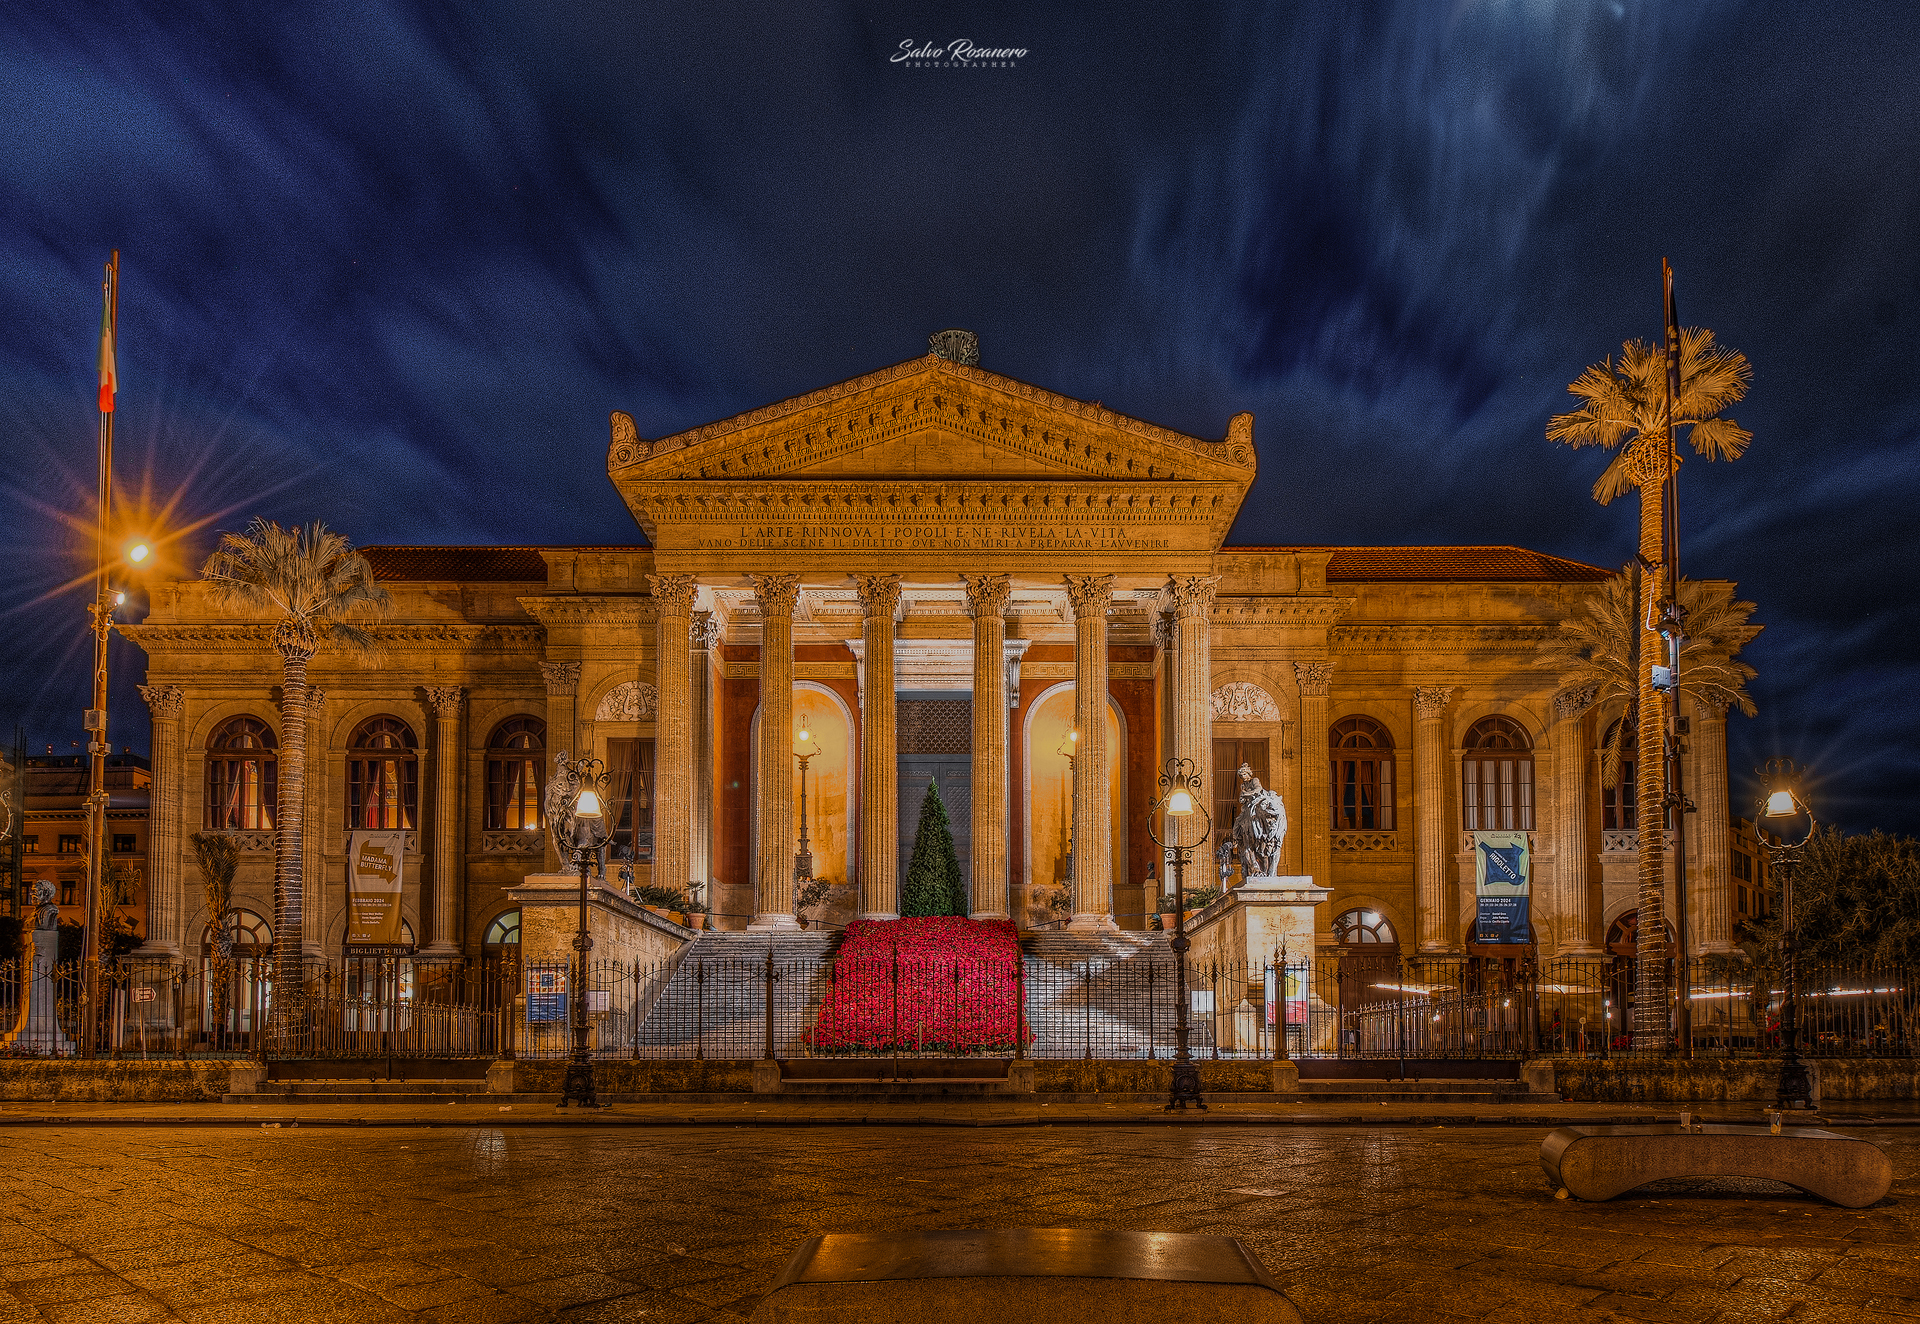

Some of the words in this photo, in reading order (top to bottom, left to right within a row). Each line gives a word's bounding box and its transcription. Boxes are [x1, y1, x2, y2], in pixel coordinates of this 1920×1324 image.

[741, 527, 794, 538] L'ARTE
[802, 527, 872, 538] RINNOVA
[893, 527, 947, 538] POPOLI
[956, 527, 964, 538] E
[972, 527, 992, 538] NE
[1001, 527, 1056, 538] RIVELA
[1066, 527, 1082, 538] LA
[1090, 527, 1127, 538] VITA
[699, 538, 732, 548] VANO
[740, 538, 774, 548] DELLE
[783, 538, 825, 548] SCENE
[833, 538, 846, 548] IL
[853, 538, 903, 548] DILETTO
[912, 538, 936, 548] OVE
[944, 538, 970, 548] NON
[981, 538, 1009, 548] MIRI
[1016, 538, 1023, 548] A
[1030, 538, 1093, 548] PREPARAR
[1100, 538, 1169, 548] L'AVVENIRE
[361, 855, 387, 865] MADAMA
[360, 861, 393, 872] BUTTERFLY
[1489, 852, 1516, 880] RIGOLETTO
[350, 947, 408, 955] BIGLIETTRIA
